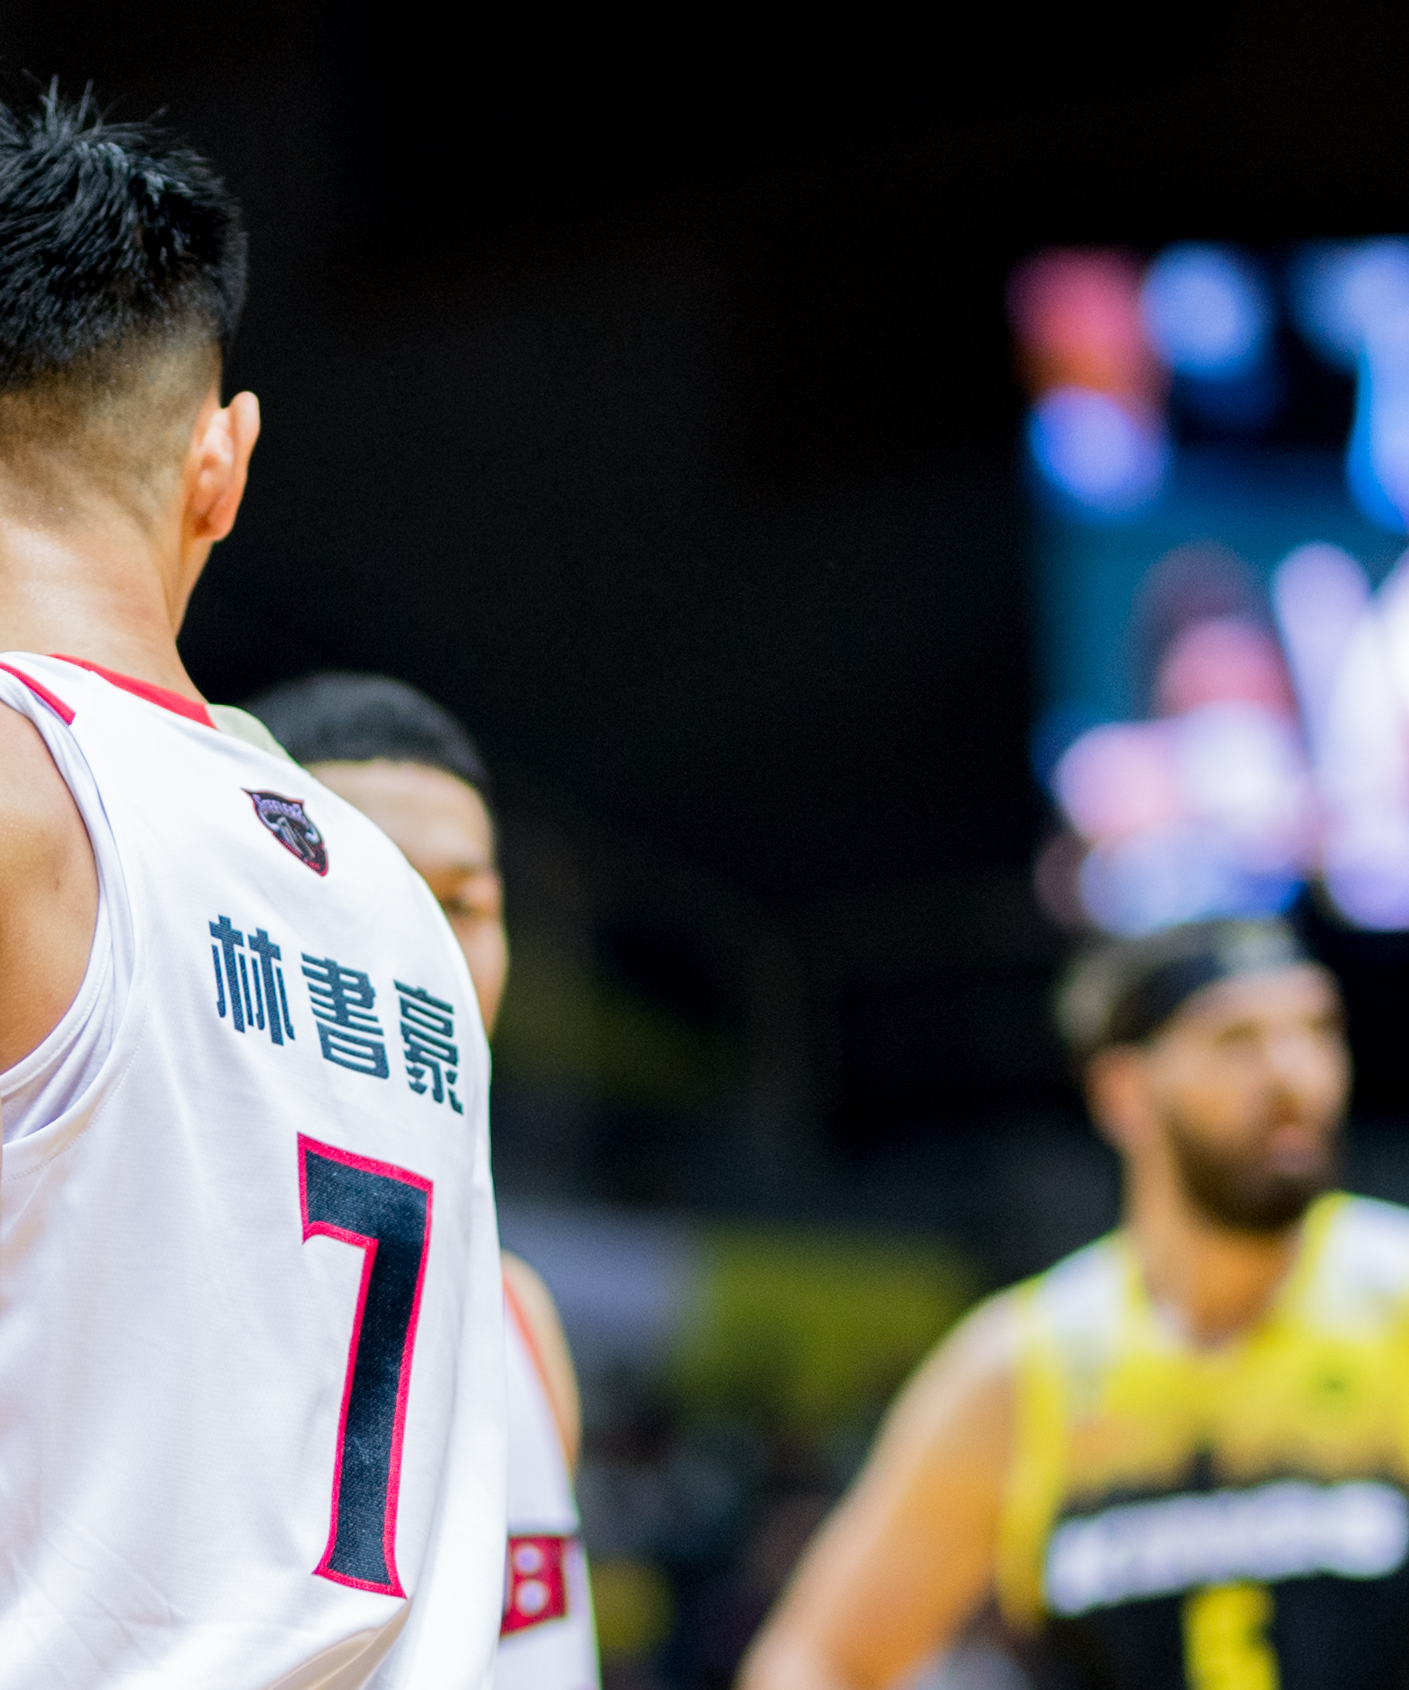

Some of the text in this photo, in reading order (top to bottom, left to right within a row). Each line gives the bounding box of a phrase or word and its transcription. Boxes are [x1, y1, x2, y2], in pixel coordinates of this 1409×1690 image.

[208, 913, 464, 1116] 林書豪
[296, 1131, 434, 1600] 7
